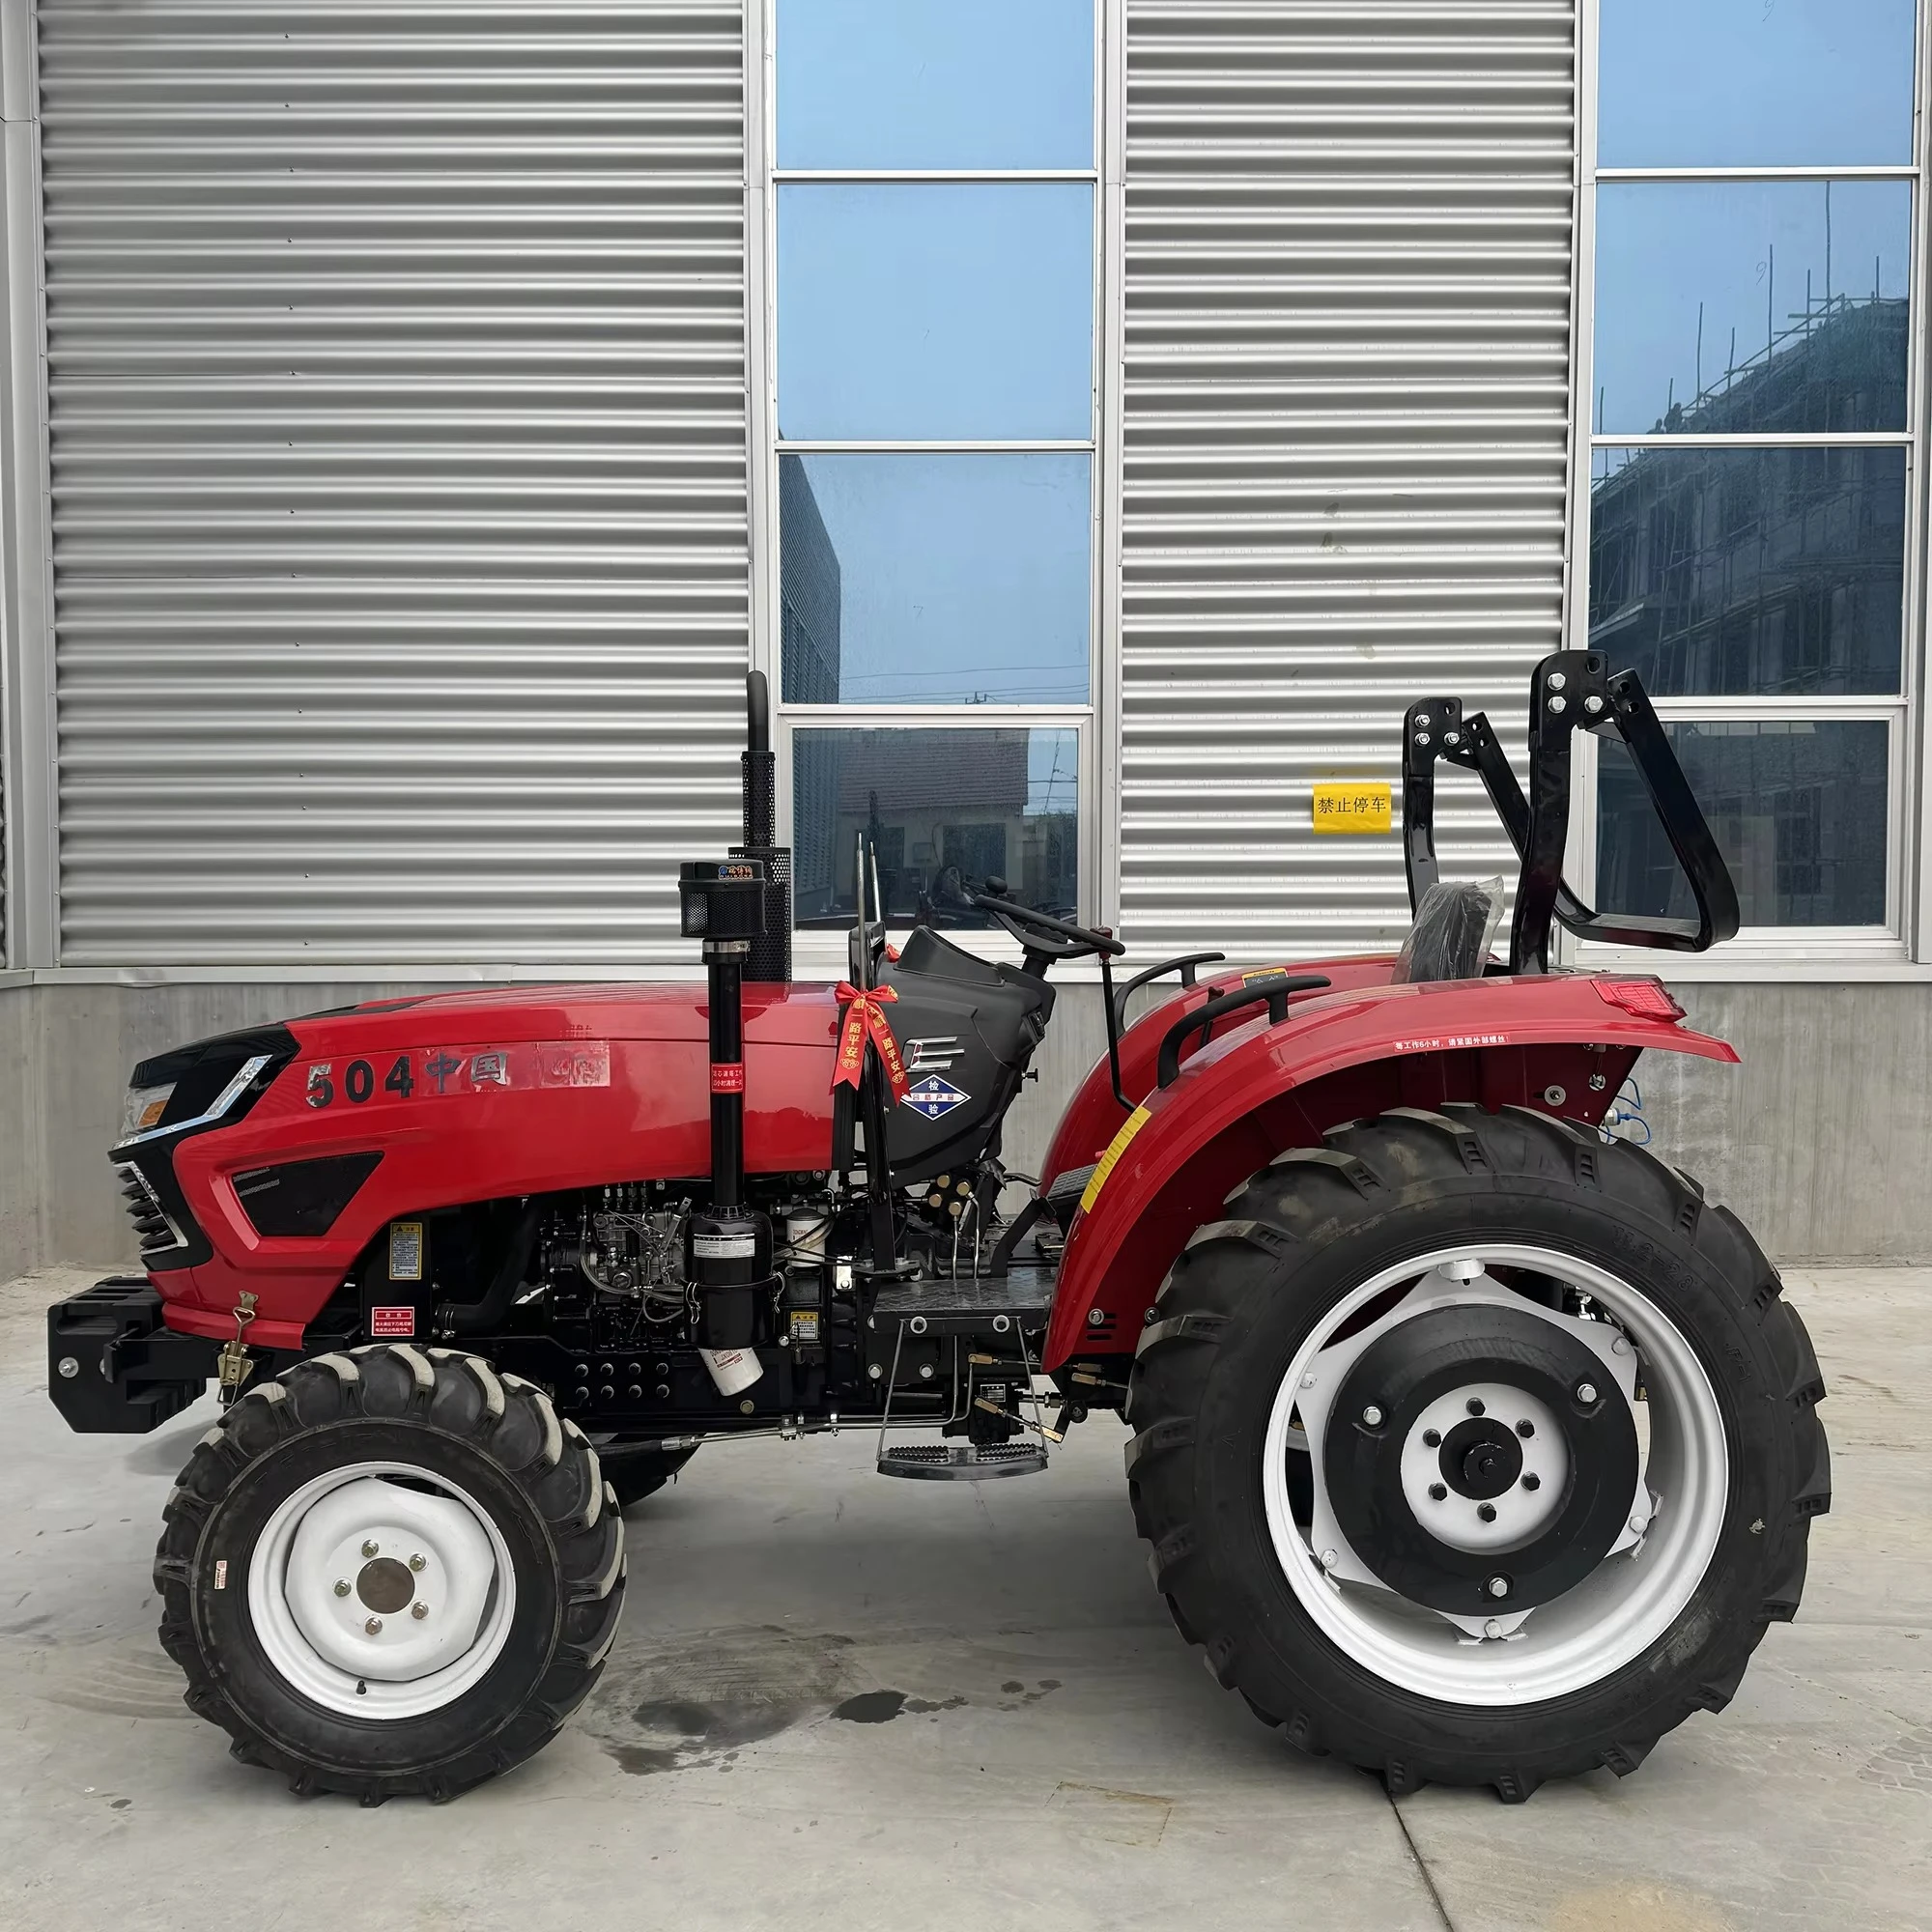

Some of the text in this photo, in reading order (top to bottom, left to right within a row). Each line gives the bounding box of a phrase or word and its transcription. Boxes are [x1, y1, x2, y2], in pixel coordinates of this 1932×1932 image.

[1318, 797, 1386, 813] 禁止停车
[305, 1056, 413, 1108] 504
[425, 1051, 510, 1094] 中国
[928, 1080, 939, 1091] 检
[928, 1103, 939, 1115] 验
